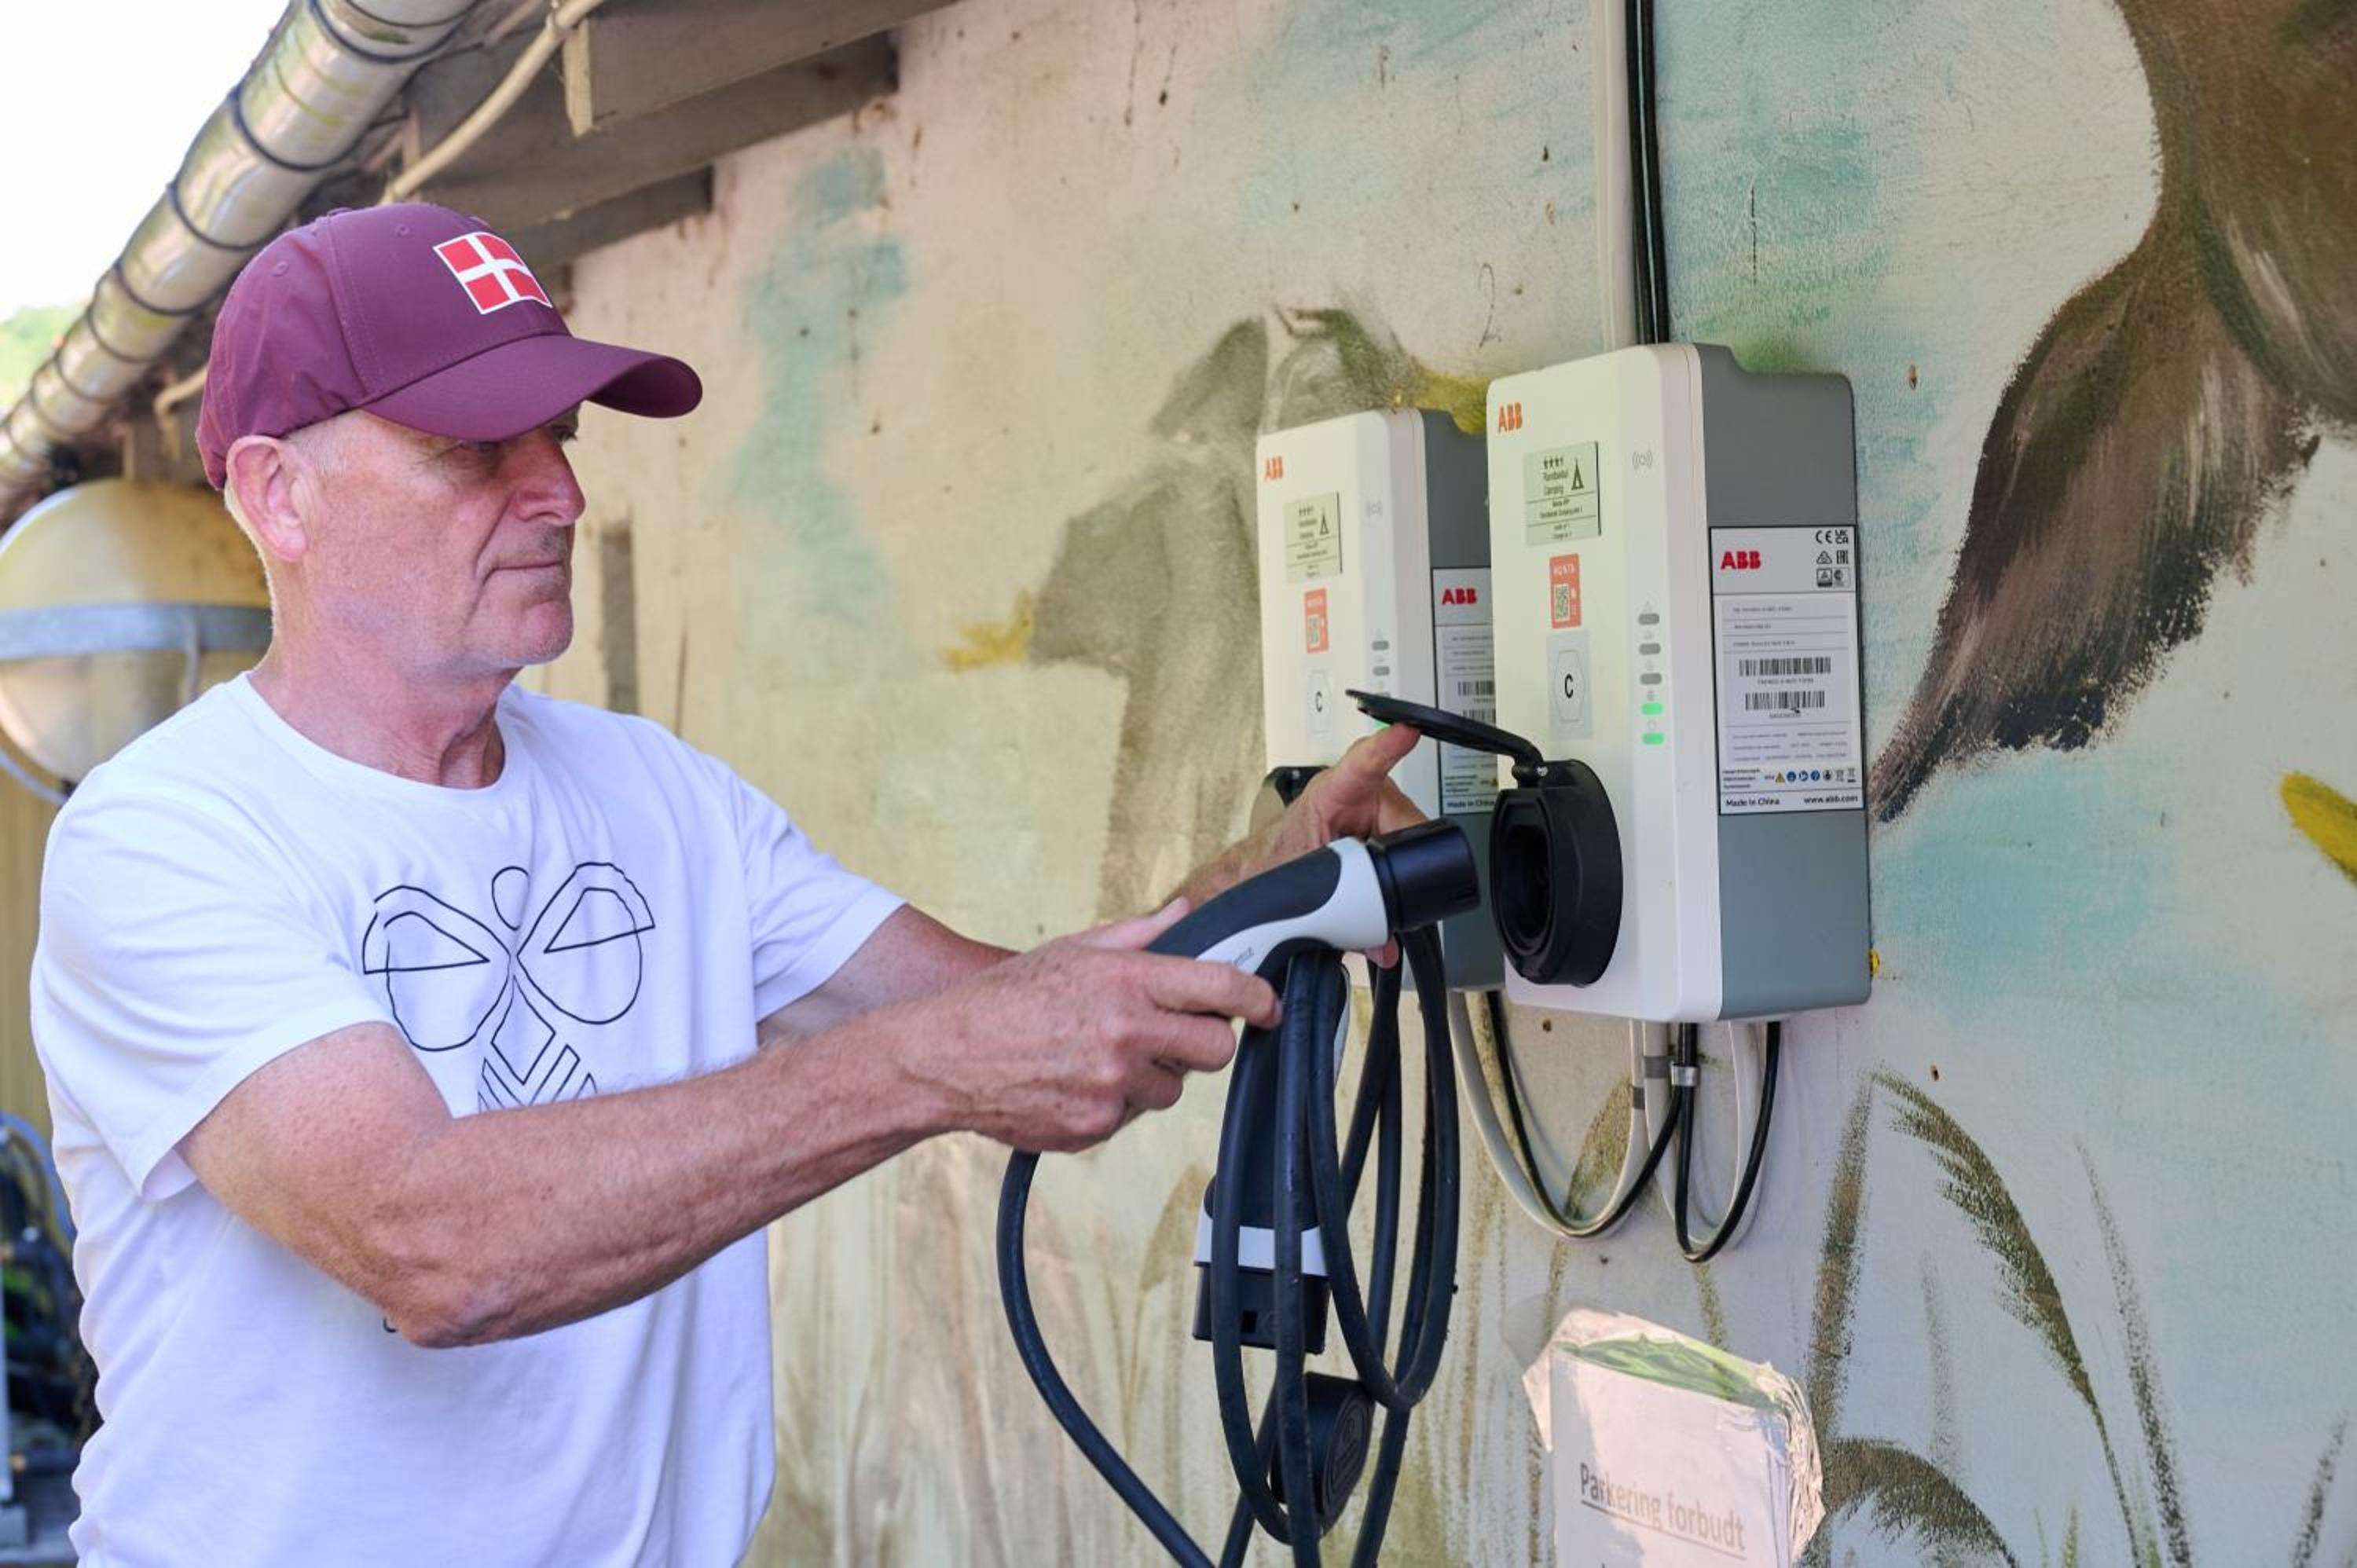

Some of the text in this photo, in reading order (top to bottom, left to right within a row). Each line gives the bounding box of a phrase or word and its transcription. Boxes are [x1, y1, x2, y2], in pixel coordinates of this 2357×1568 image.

[1497, 402, 1523, 434] ABB
[1264, 456, 1284, 482] ABB
[1721, 551, 1761, 570] ABB
[1441, 588, 1478, 605] ABB
[1564, 673, 1574, 699] C
[1315, 691, 1323, 713] C
[1804, 794, 1859, 804] www.abb.com
[1580, 1462, 1746, 1551] Parkering forbudt
